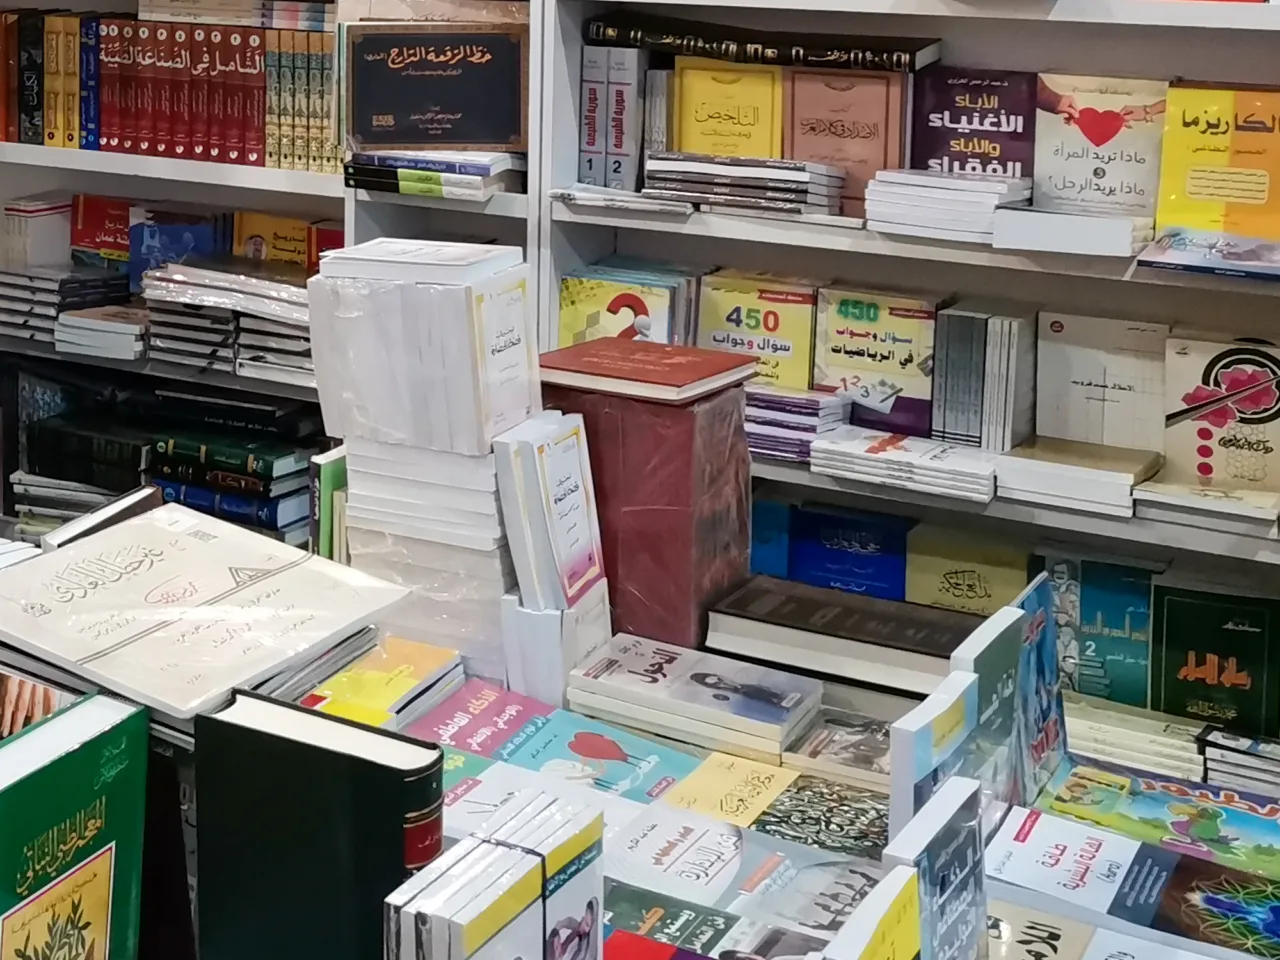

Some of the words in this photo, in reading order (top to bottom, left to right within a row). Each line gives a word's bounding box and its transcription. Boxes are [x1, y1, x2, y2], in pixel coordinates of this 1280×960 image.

[137, 42, 192, 71] الصناعة
[190, 43, 211, 77] في
[209, 43, 266, 76] الشامل
[694, 101, 760, 128] التلخيص
[928, 109, 1025, 134] الأغنياء
[1052, 141, 1090, 162] المرأة
[1091, 150, 1118, 165] تريد
[1120, 149, 1147, 165] ماذا
[586, 157, 593, 172] 1
[613, 159, 623, 174] 2
[926, 156, 1023, 179] الفقراء
[1120, 182, 1146, 198] ماذا
[725, 305, 780, 333] 450
[836, 298, 881, 323] 450
[711, 333, 755, 350] وجواب
[835, 326, 878, 342] وجواب
[879, 330, 913, 344] سؤال
[756, 338, 791, 354] سؤال
[830, 344, 896, 363] الرياضيات
[898, 349, 915, 370] في
[1084, 641, 1097, 656] 2
[626, 646, 683, 684] التحول
[468, 689, 500, 716] الذكاء
[432, 711, 473, 748] العاطفي
[1034, 841, 1068, 869] طاقة
[1072, 835, 1106, 863] الهالة
[1056, 858, 1094, 892] البشرية
